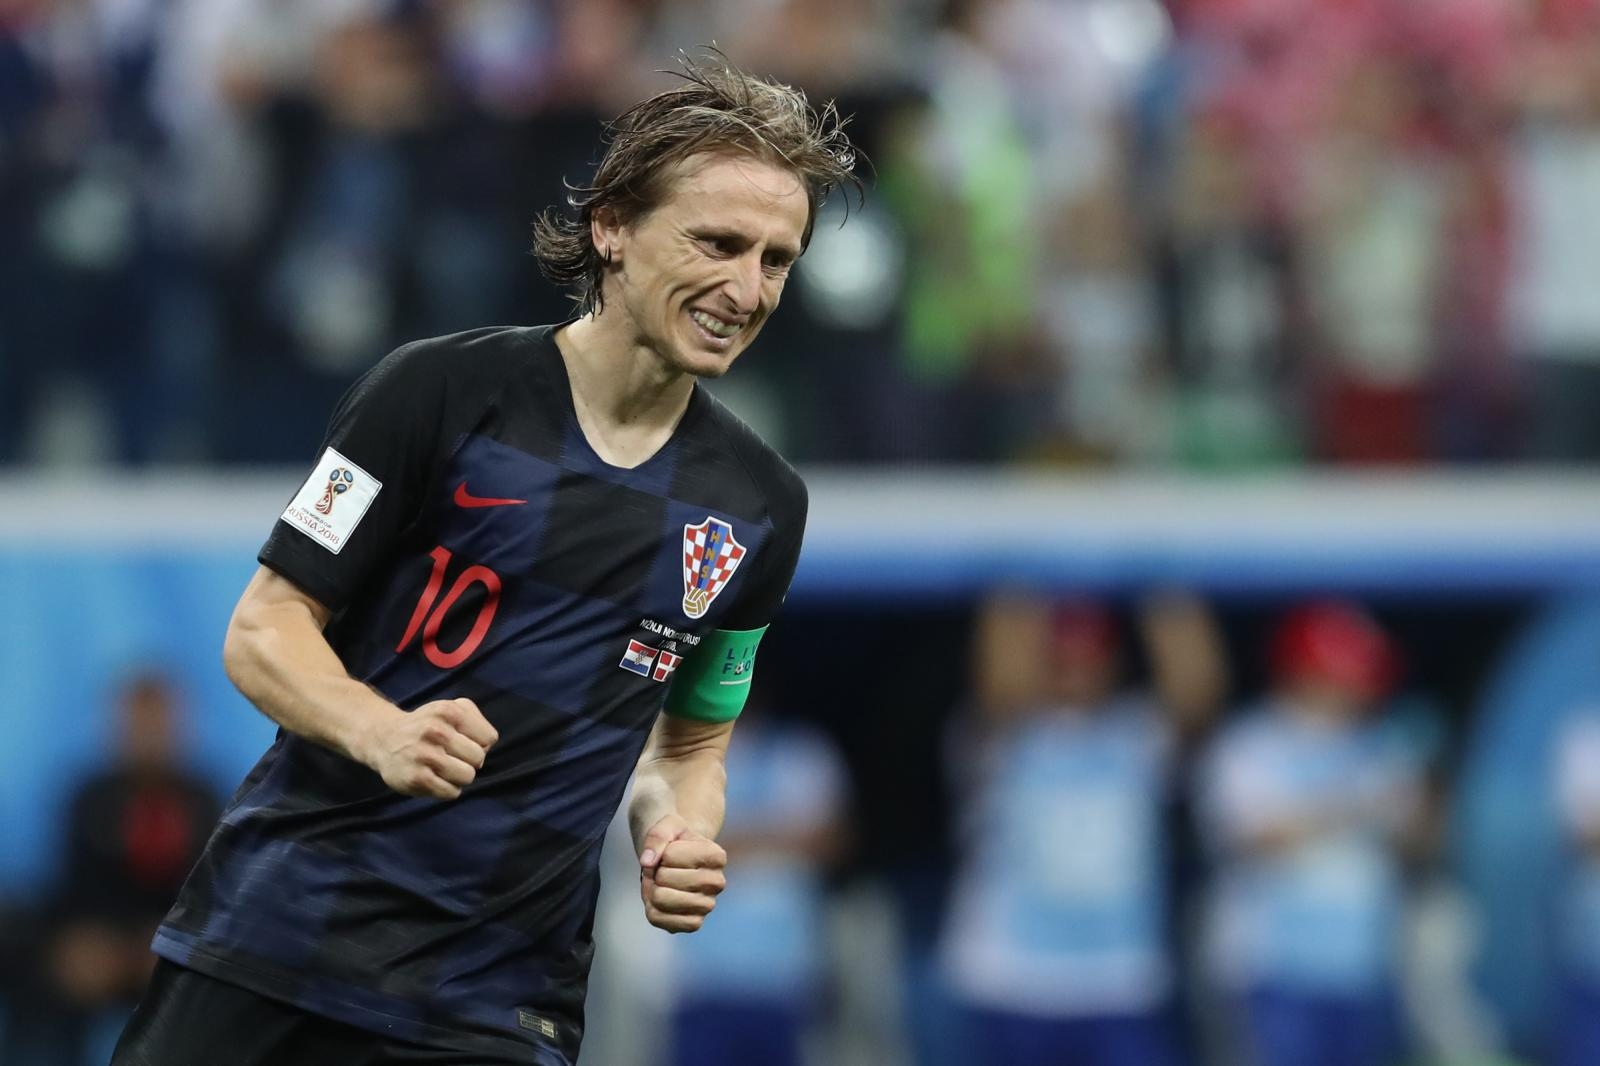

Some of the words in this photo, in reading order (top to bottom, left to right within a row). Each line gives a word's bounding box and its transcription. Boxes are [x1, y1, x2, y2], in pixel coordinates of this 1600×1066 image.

[288, 505, 318, 530] RUSSIA
[318, 527, 340, 545] 2018
[395, 545, 502, 669] 10
